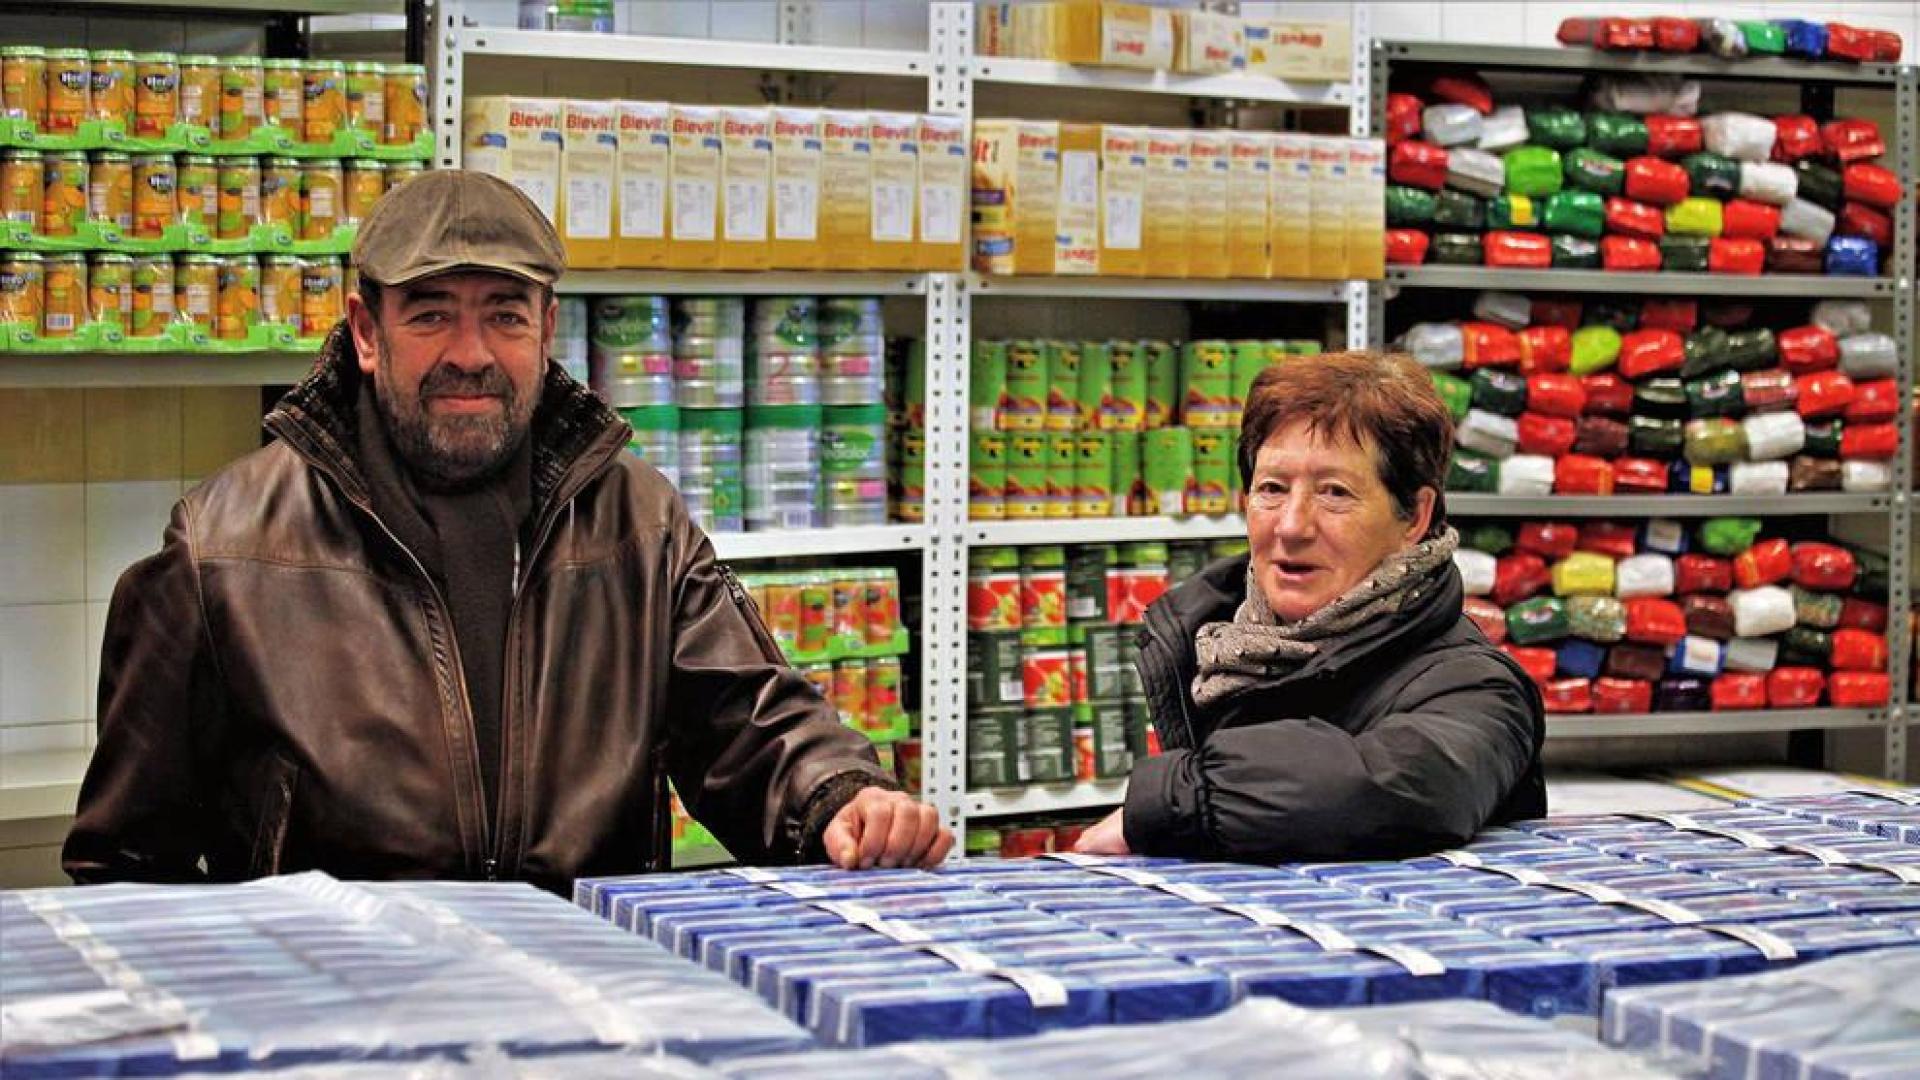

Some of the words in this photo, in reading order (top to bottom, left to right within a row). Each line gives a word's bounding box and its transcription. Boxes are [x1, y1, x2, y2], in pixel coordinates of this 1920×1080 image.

[509, 111, 554, 128] Blevit
[566, 113, 611, 131] Blevit
[620, 114, 662, 130] Blevit
[673, 119, 715, 133] Blevit
